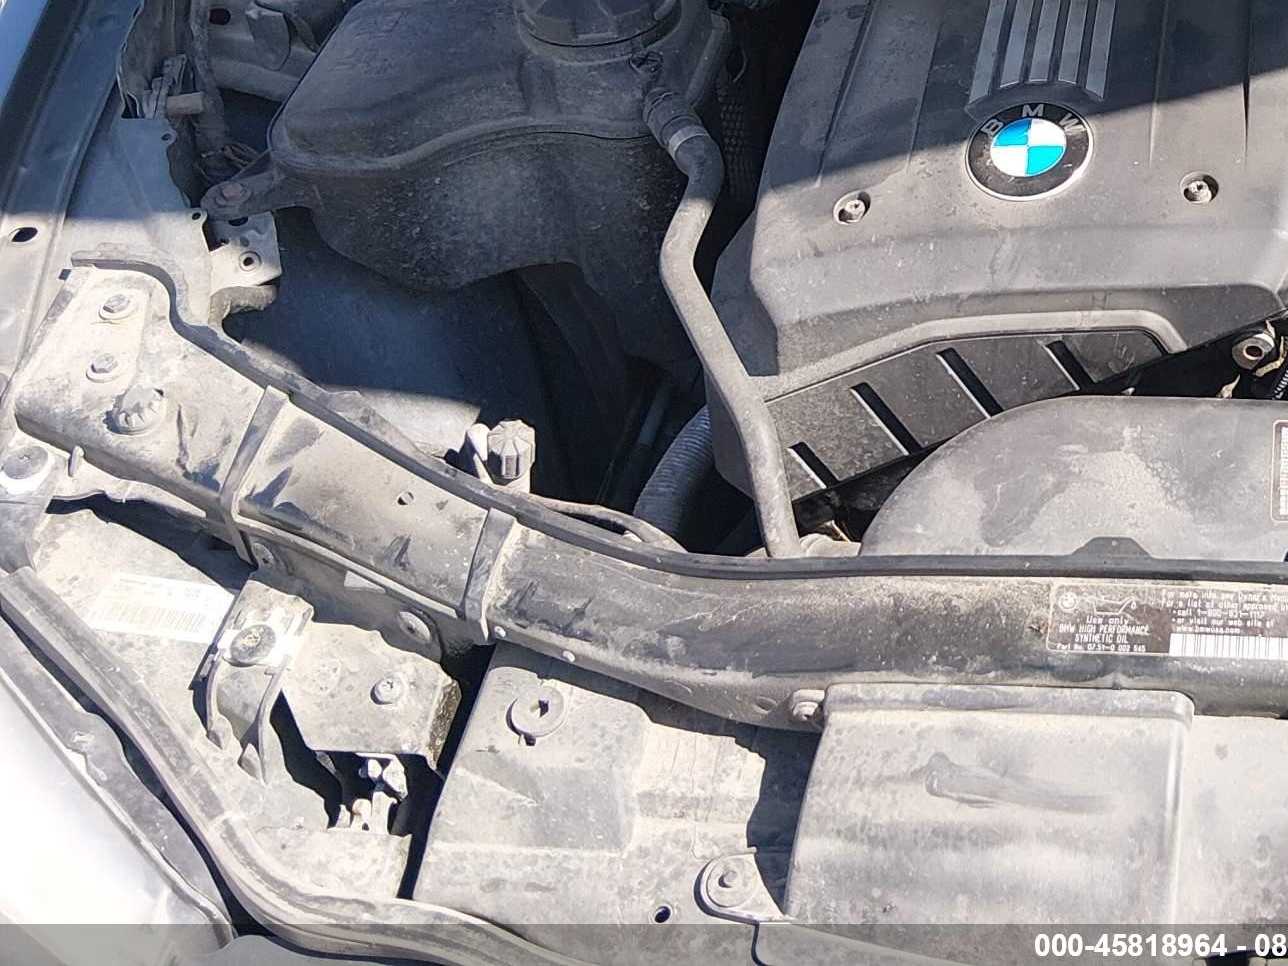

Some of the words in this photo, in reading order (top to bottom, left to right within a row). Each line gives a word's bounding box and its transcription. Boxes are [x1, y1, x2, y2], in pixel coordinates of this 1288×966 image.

[981, 103, 1088, 136] BMW
[1086, 615, 1103, 624] Use
[1108, 616, 1129, 625] only
[1059, 623, 1076, 633] BMW
[1079, 624, 1096, 634] HIGH
[1099, 625, 1150, 635] PERFORMANCE
[1075, 634, 1114, 643] SYNTHETIC
[1116, 634, 1129, 643] OIL
